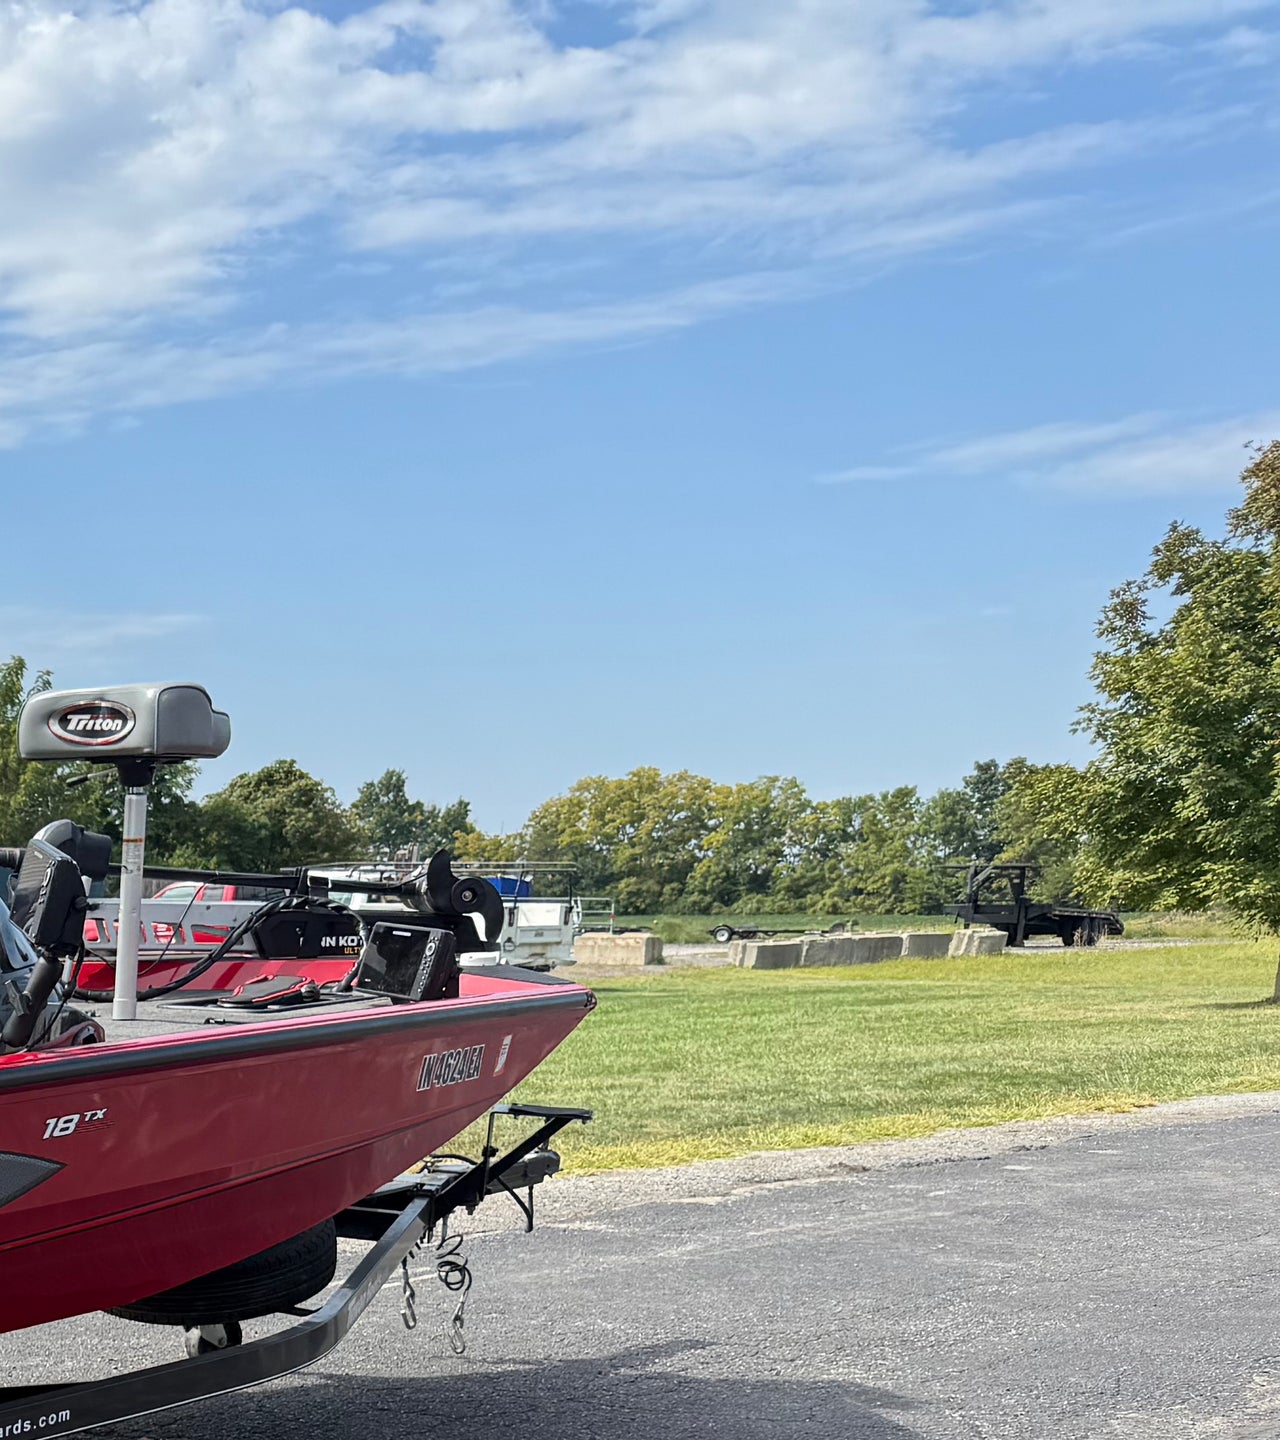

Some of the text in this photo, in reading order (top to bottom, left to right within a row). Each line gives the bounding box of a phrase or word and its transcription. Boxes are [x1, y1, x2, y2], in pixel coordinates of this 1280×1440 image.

[67, 714, 123, 731] Triton
[42, 1107, 108, 1140] 18 TX
